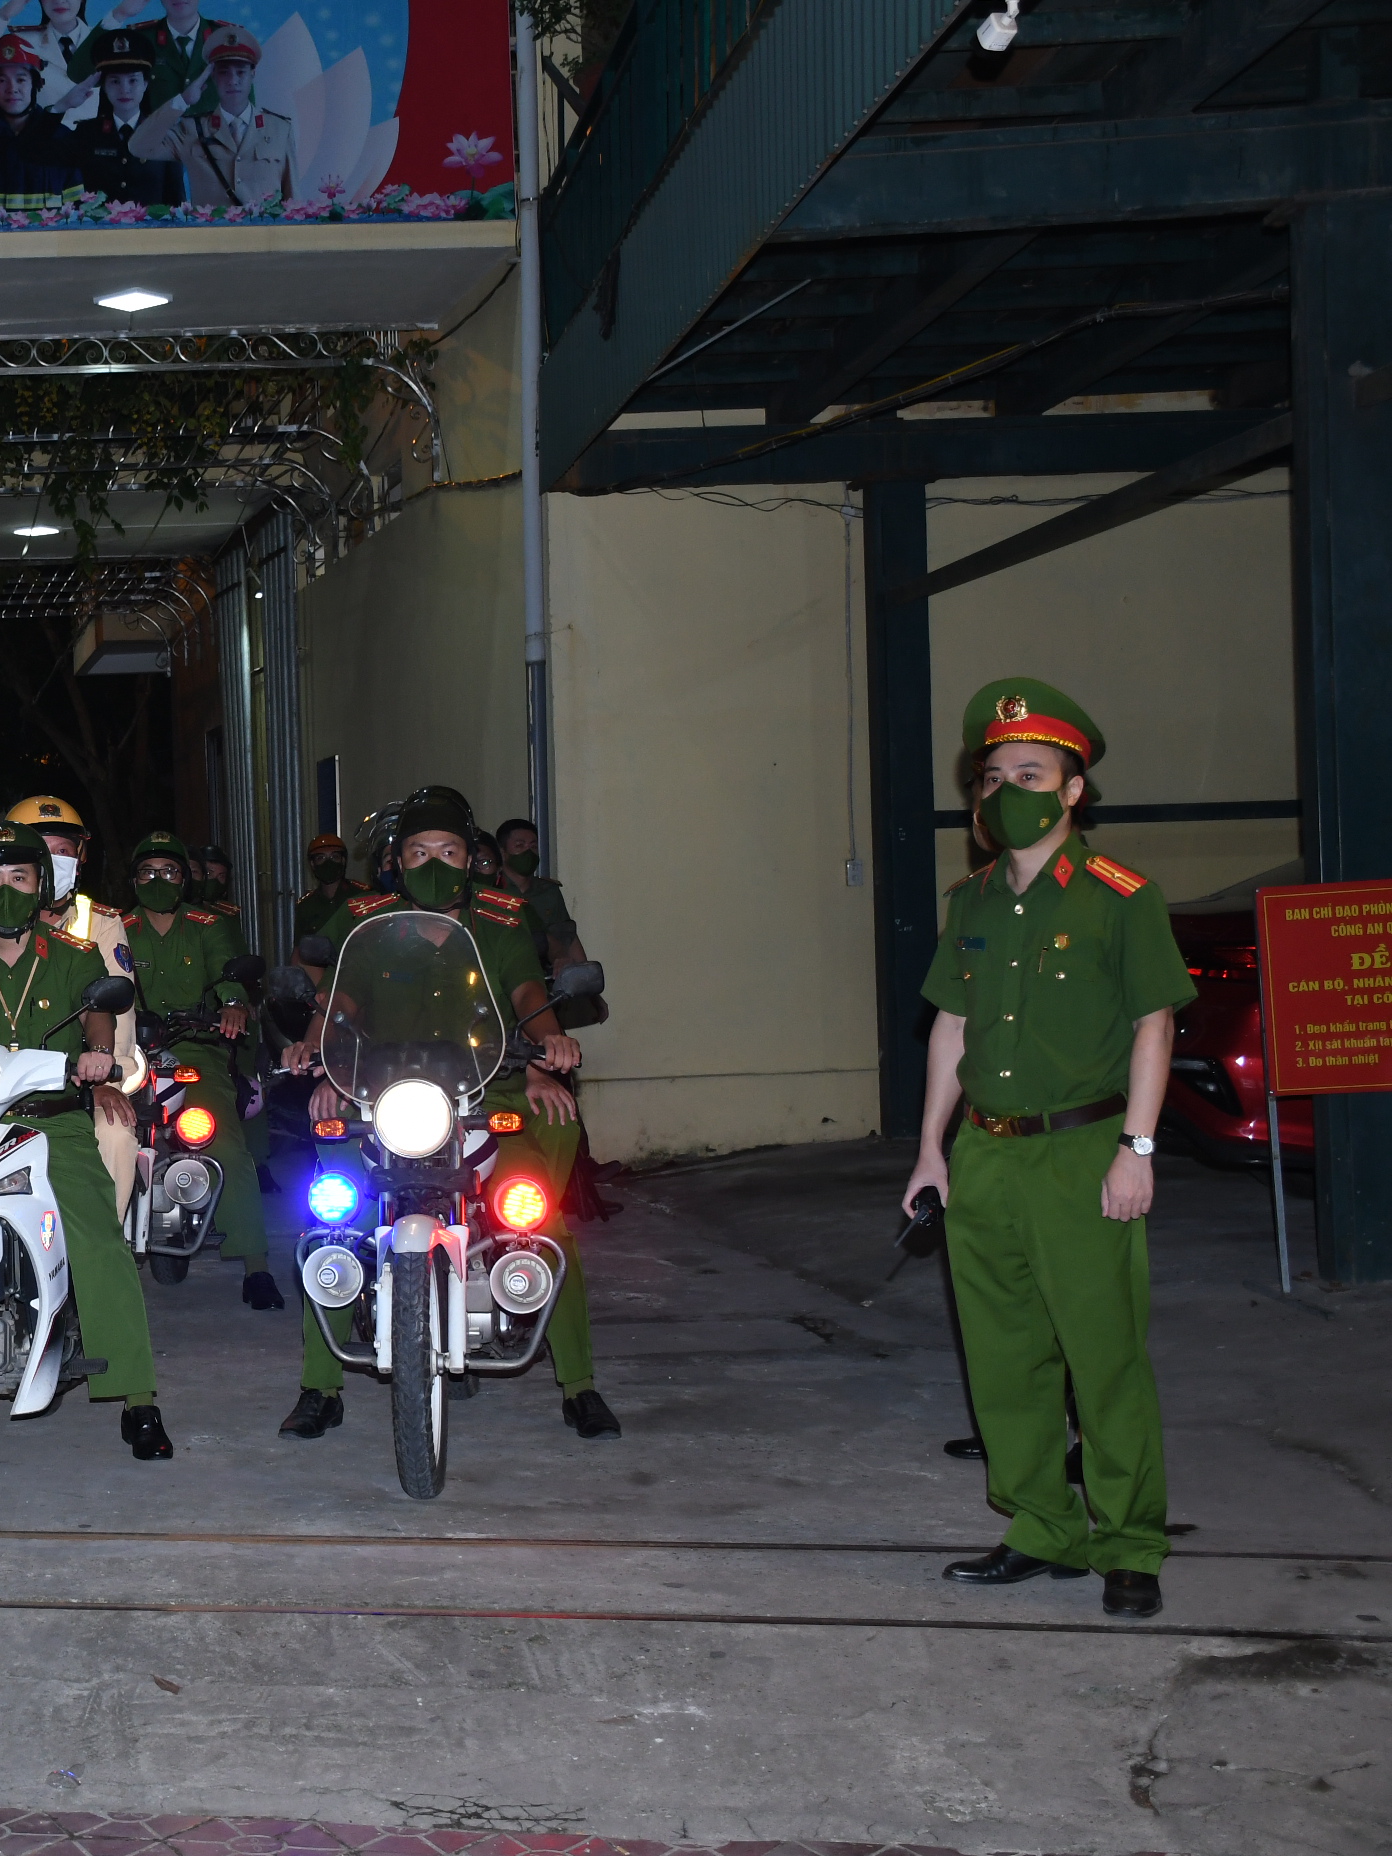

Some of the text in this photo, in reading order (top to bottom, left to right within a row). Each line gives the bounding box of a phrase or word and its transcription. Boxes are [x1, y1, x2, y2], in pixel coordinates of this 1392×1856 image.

[1285, 908, 1310, 921] BAN
[1312, 902, 1333, 919] CHỈ
[1335, 904, 1359, 920] ĐẠO
[1330, 922, 1363, 937] CÔNG
[1366, 922, 1384, 935] AN
[1350, 943, 1391, 970] ĐỀ
[1288, 979, 1320, 993] CÁN
[1344, 994, 1369, 1007] TẠI
[1294, 1024, 1304, 1035] 1.
[1306, 1023, 1327, 1034] Đeo
[1329, 1019, 1357, 1033] khẩu
[1358, 1021, 1387, 1031] trang
[1295, 1041, 1305, 1051] 2.
[1308, 1040, 1323, 1052] Xịt
[1325, 1039, 1342, 1050] sát
[1344, 1035, 1377, 1048] khuẩn
[1296, 1053, 1379, 1067] 3. Đo thân nhiệt
